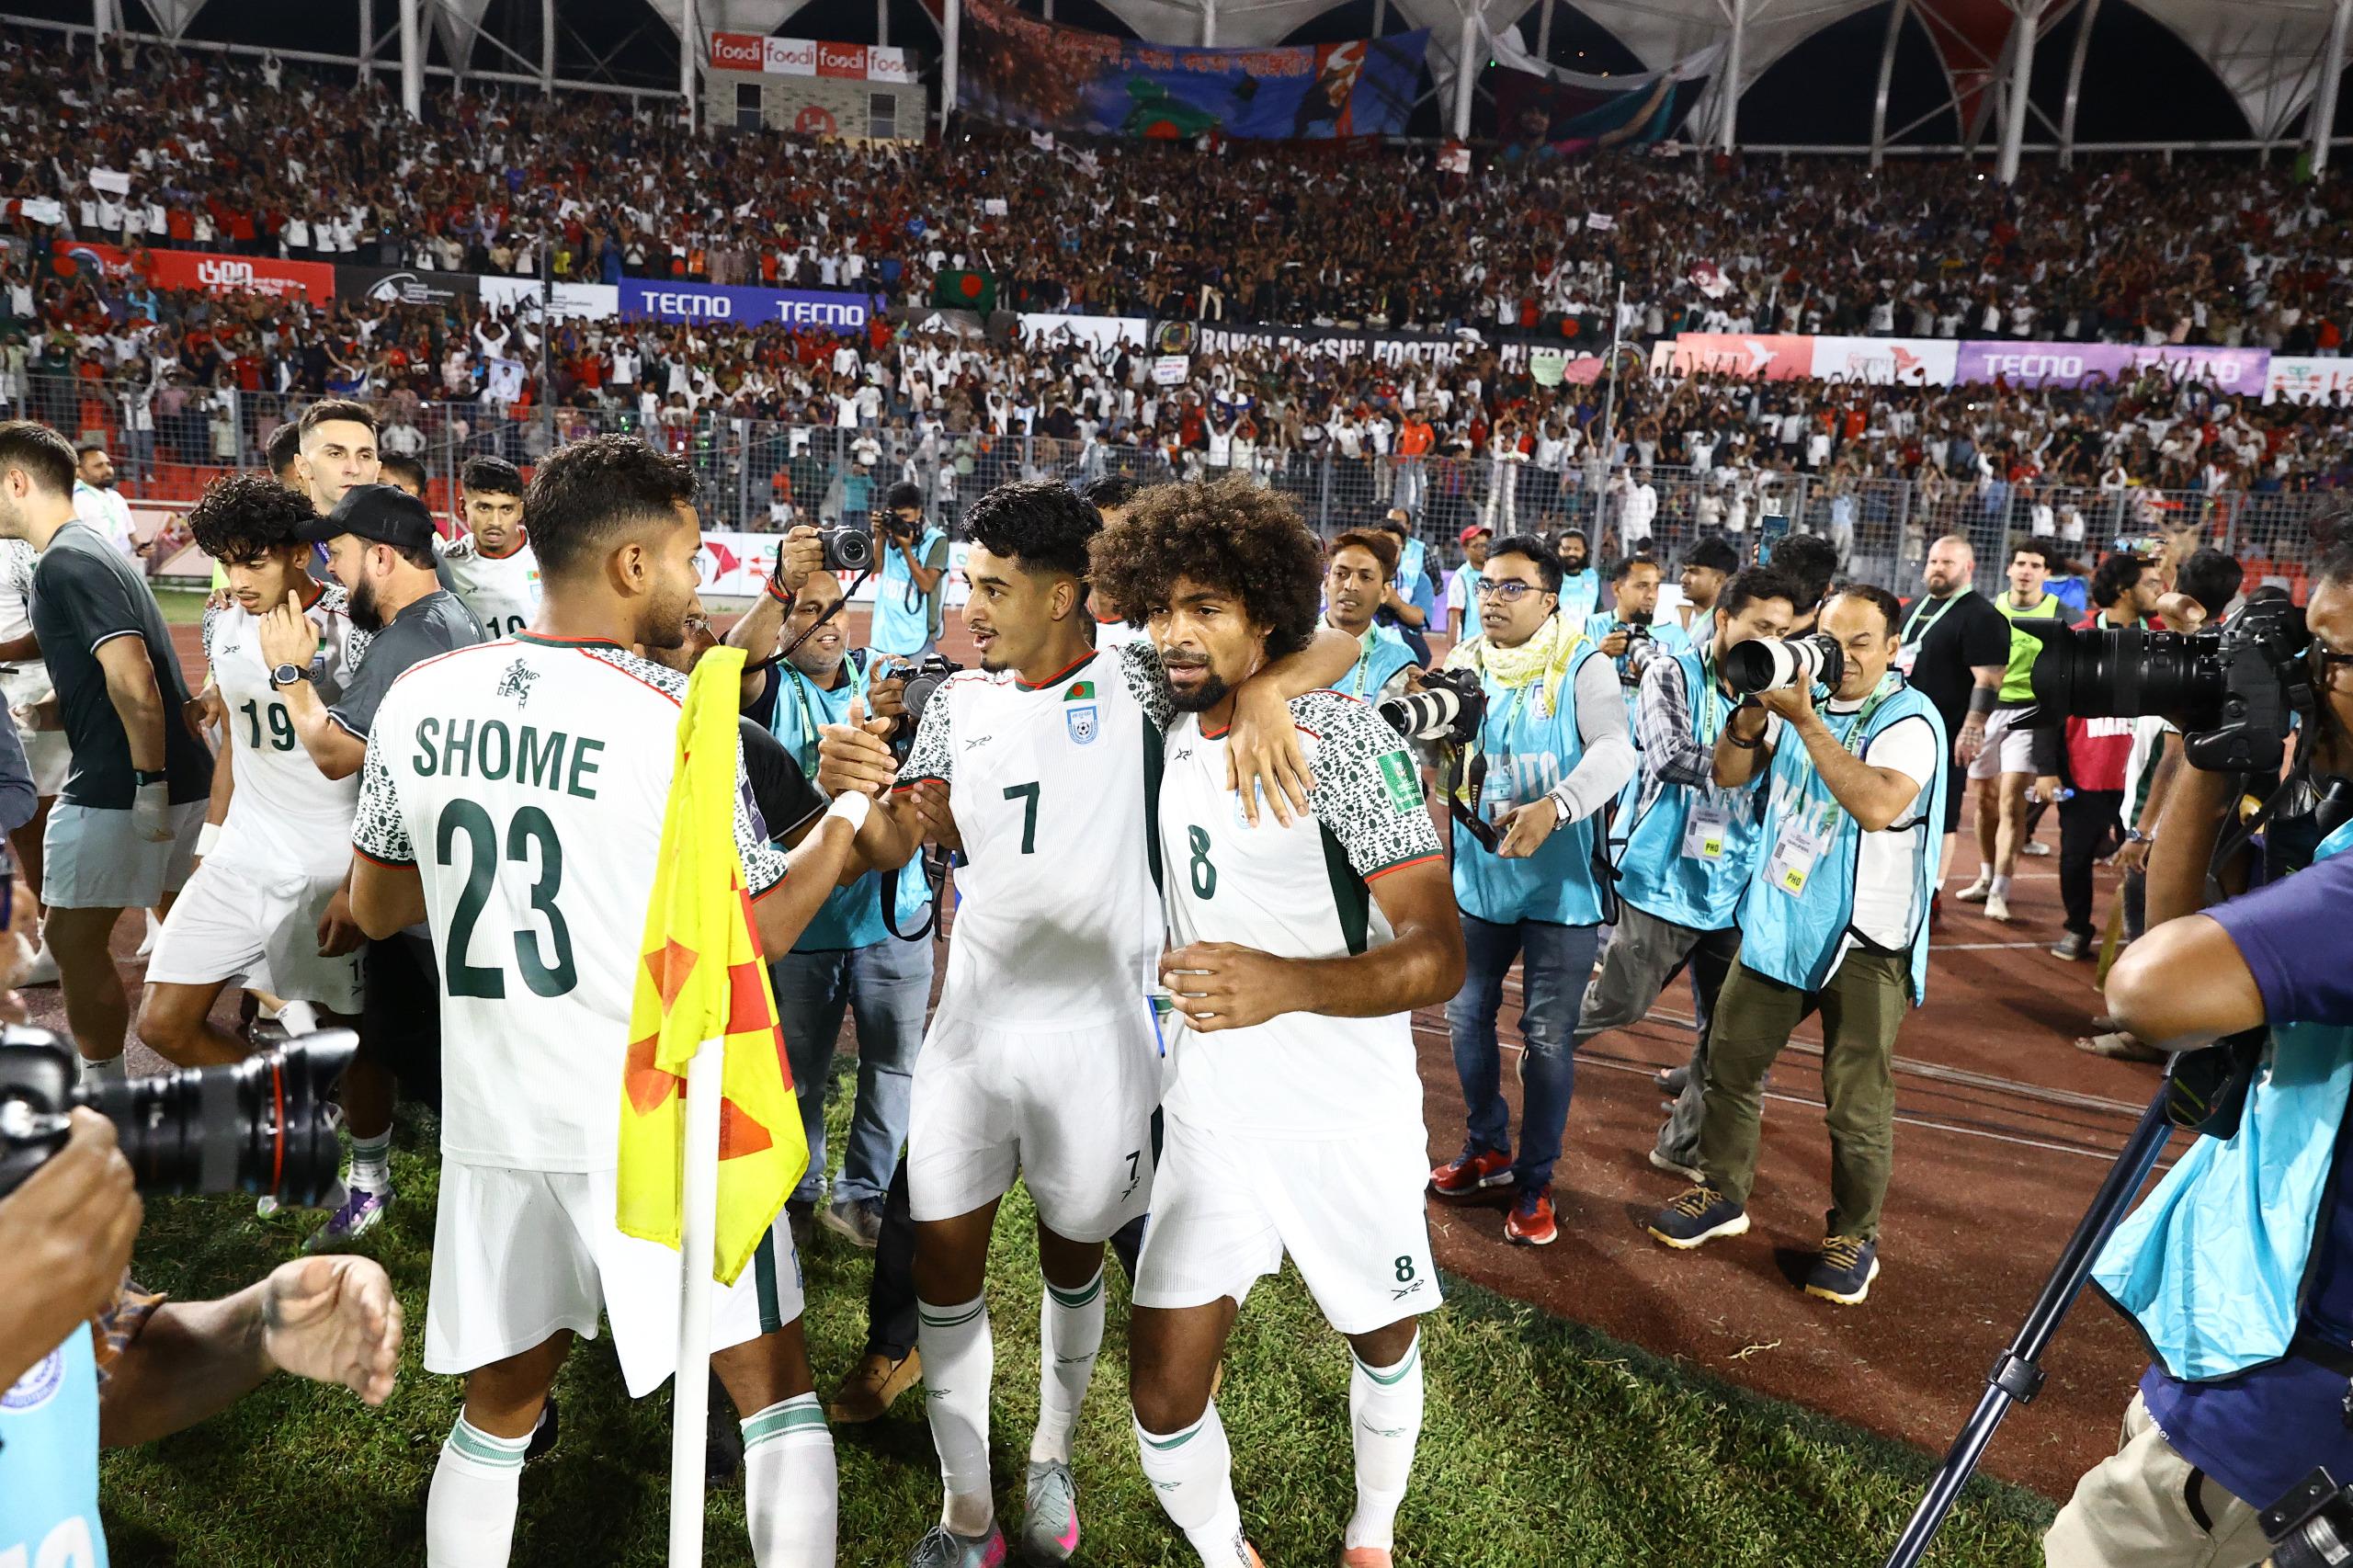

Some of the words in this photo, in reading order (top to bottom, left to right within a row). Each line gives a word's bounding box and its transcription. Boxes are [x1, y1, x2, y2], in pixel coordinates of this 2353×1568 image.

[714, 39, 760, 61] foodi
[766, 41, 814, 65] foodi
[819, 47, 865, 69] foodi
[870, 51, 911, 74] foo
[641, 290, 732, 318] TECNO
[776, 301, 865, 327] TECNO
[1983, 354, 2083, 379] TECNO
[240, 699, 295, 751] 19
[412, 717, 606, 800] SHOME
[1003, 780, 1040, 855] 7
[1188, 824, 1217, 901] 8
[1786, 872, 1802, 886] PHO
[437, 798, 578, 1000] 23
[1126, 1150, 1141, 1182] 7
[1394, 1255, 1415, 1282] 8
